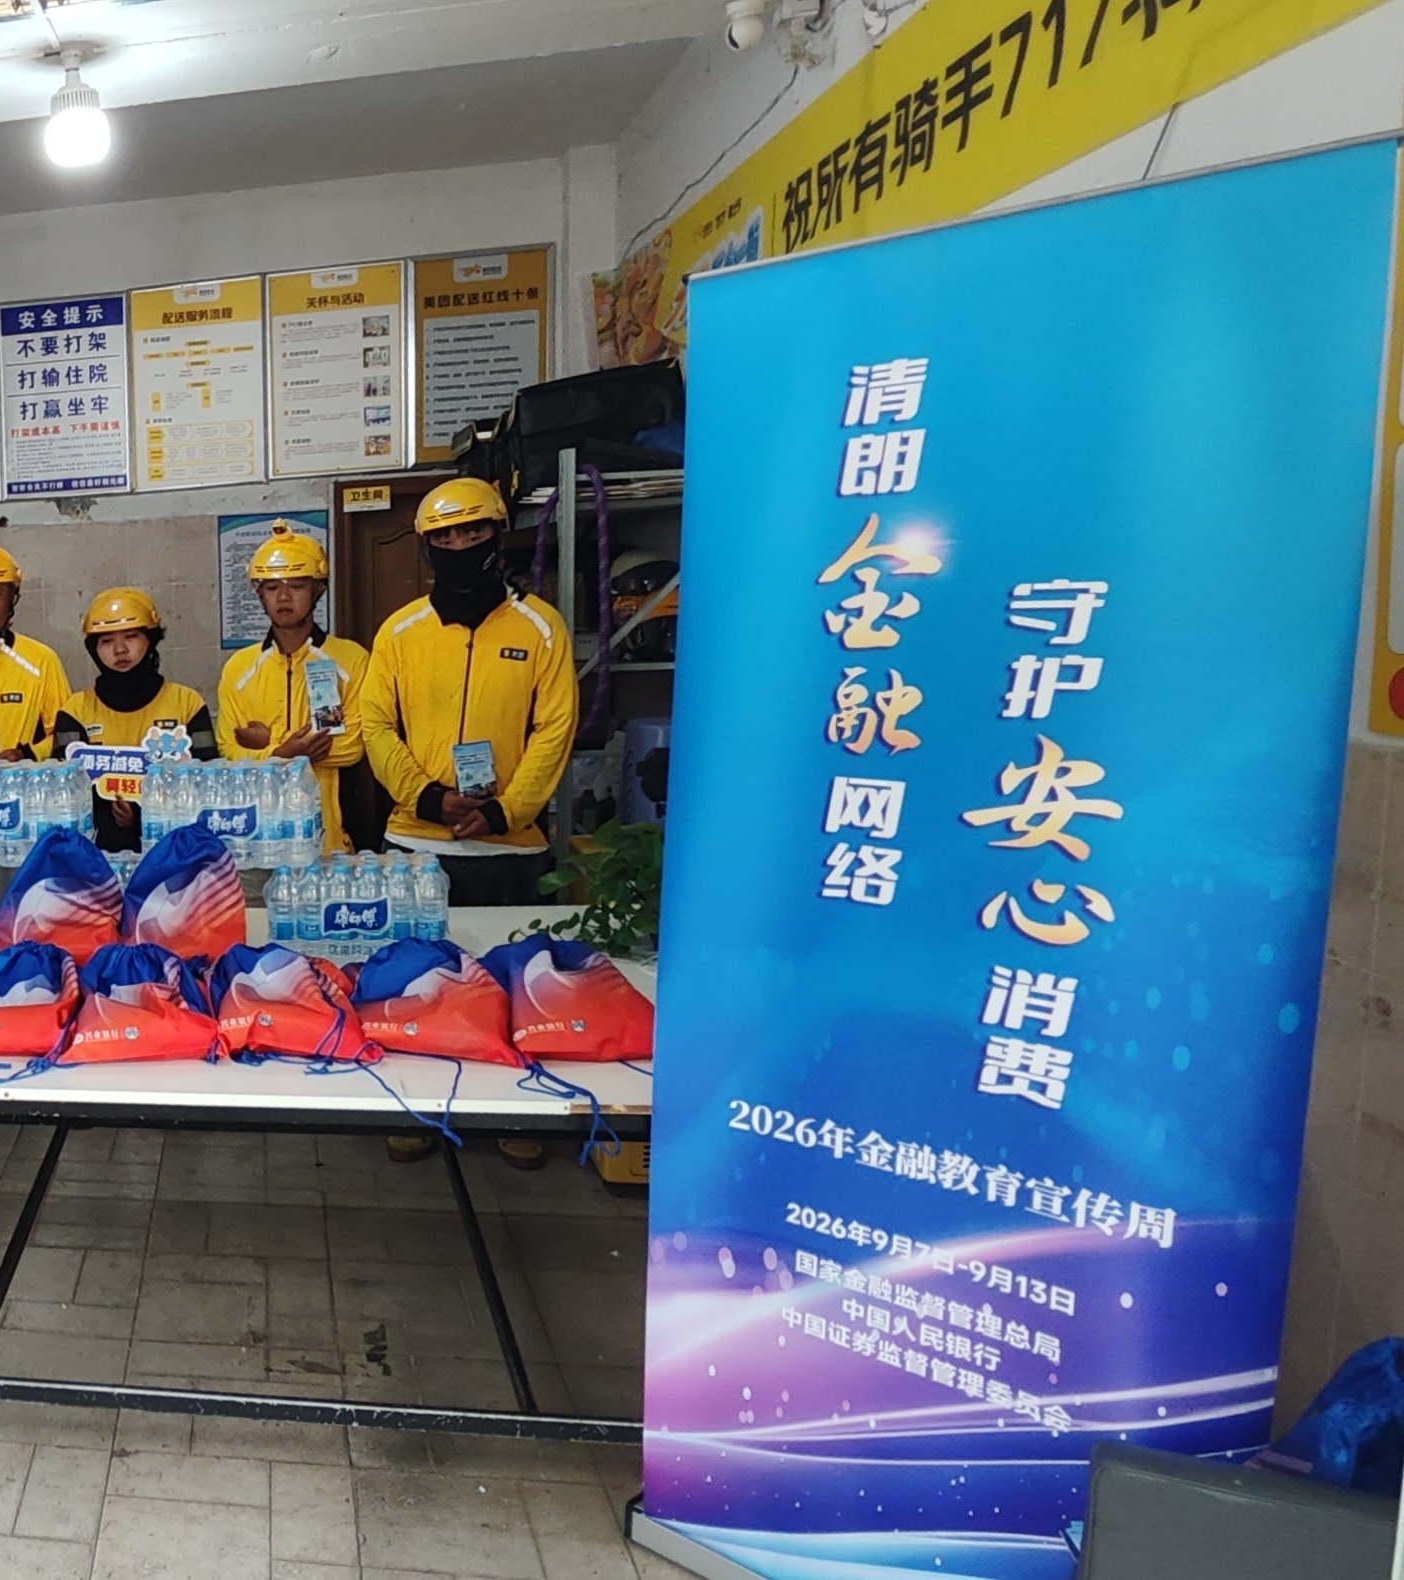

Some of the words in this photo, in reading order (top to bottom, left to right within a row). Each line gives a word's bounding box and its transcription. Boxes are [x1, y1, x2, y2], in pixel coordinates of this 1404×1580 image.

[782, 0, 1201, 254] 祝所有骑手717
[306, 292, 365, 309] 关怀与活动
[423, 287, 539, 309] 美团配送红线十条
[18, 304, 104, 330] 安全提示
[162, 307, 233, 325] 配送服务流程
[17, 332, 107, 358] 不要打架
[18, 363, 109, 390] 打输住院
[20, 394, 110, 421] 打赢坐牢
[11, 425, 61, 439] 打架成本高
[69, 420, 120, 434] 下手需谨慎
[350, 490, 384, 502] 卫生间
[818, 357, 942, 906] 清朗金融网络
[207, 811, 248, 835] 康师傅
[962, 578, 1124, 1111] 守护安心消费
[334, 904, 378, 929] 康师傅
[728, 1099, 1177, 1249] 2026年金融教育宣传周
[785, 1203, 1077, 1317] 2026年9月7日-9月13日
[794, 1249, 1062, 1364] 国家金融监督管理总局
[841, 1297, 1002, 1372] 中国人民银行
[780, 1305, 1074, 1434] 中国证券监督管理委员会
